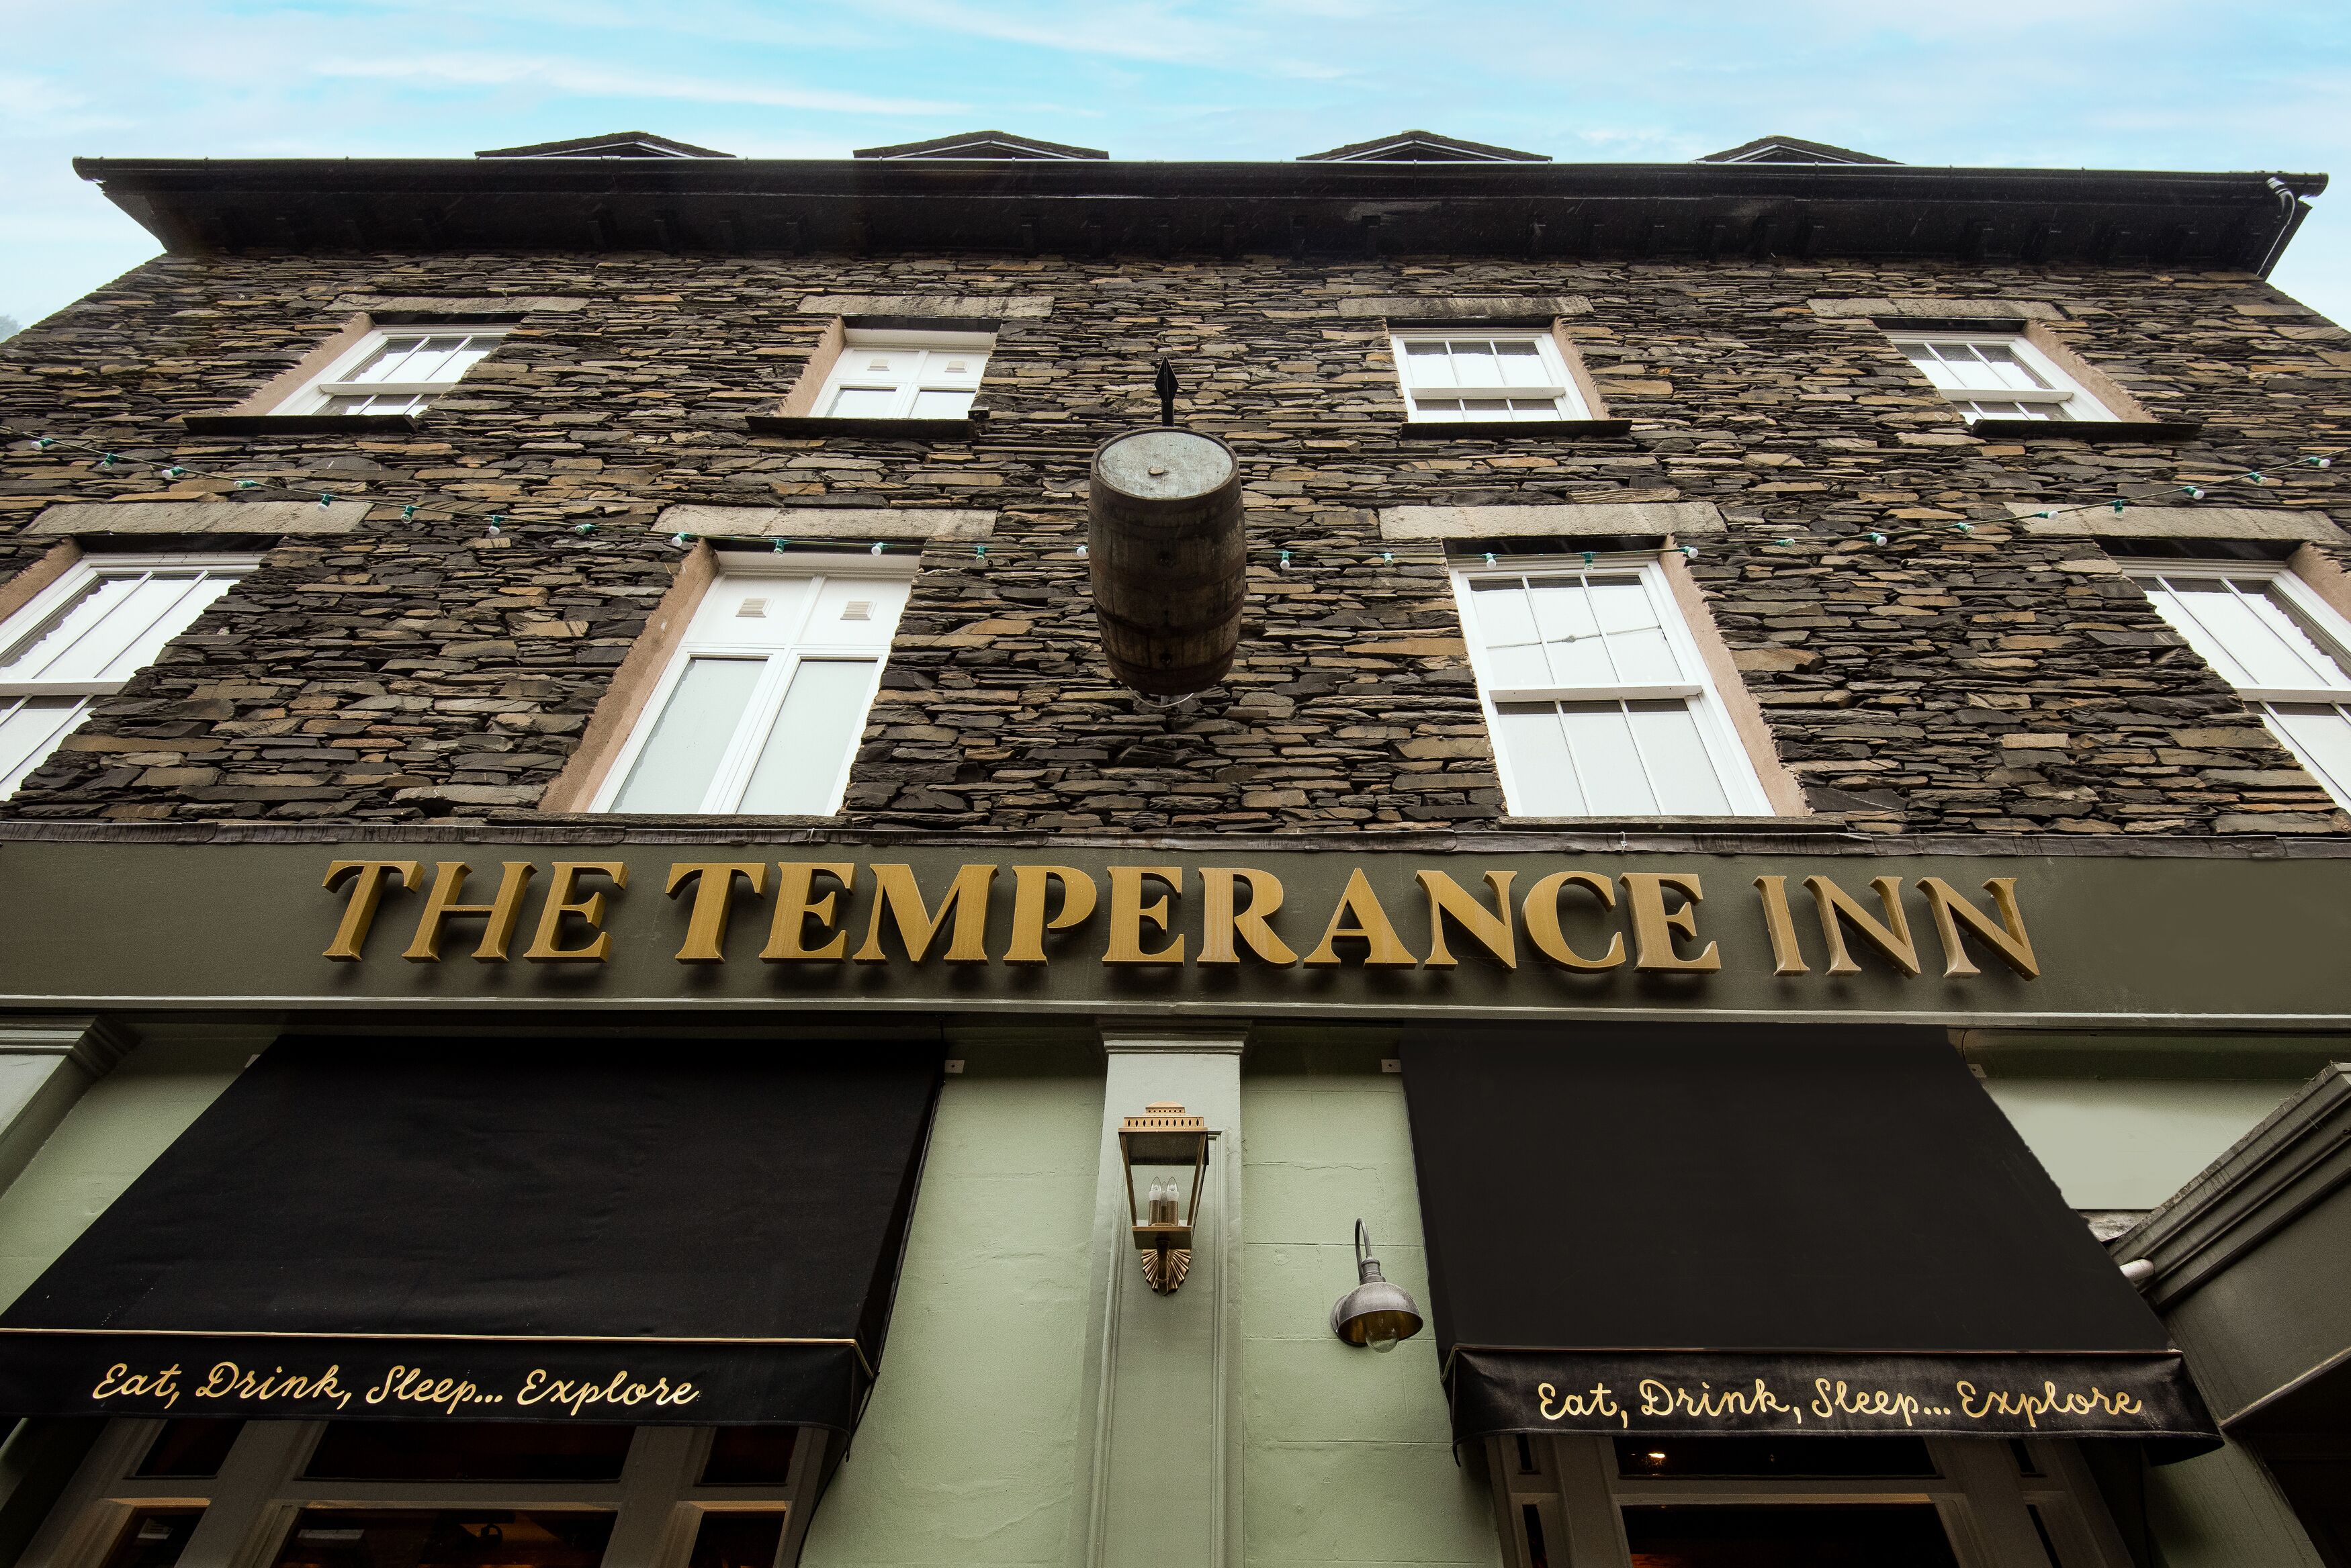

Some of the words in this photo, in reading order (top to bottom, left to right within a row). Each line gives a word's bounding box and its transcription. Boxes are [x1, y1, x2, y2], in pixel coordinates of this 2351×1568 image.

[322, 860, 630, 964] THE
[664, 860, 1722, 975] TEMPERANCE
[1752, 875, 2041, 982] INN
[92, 1363, 181, 1410] Eat,
[195, 1361, 353, 1411] Drink,
[365, 1365, 503, 1415] Sleep...
[517, 1369, 700, 1416] Explore
[1538, 1381, 1628, 1429] Eat,
[1639, 1378, 1802, 1424] Drink,
[1811, 1377, 1951, 1427] Sleep...
[1956, 1380, 2143, 1428] Explore
